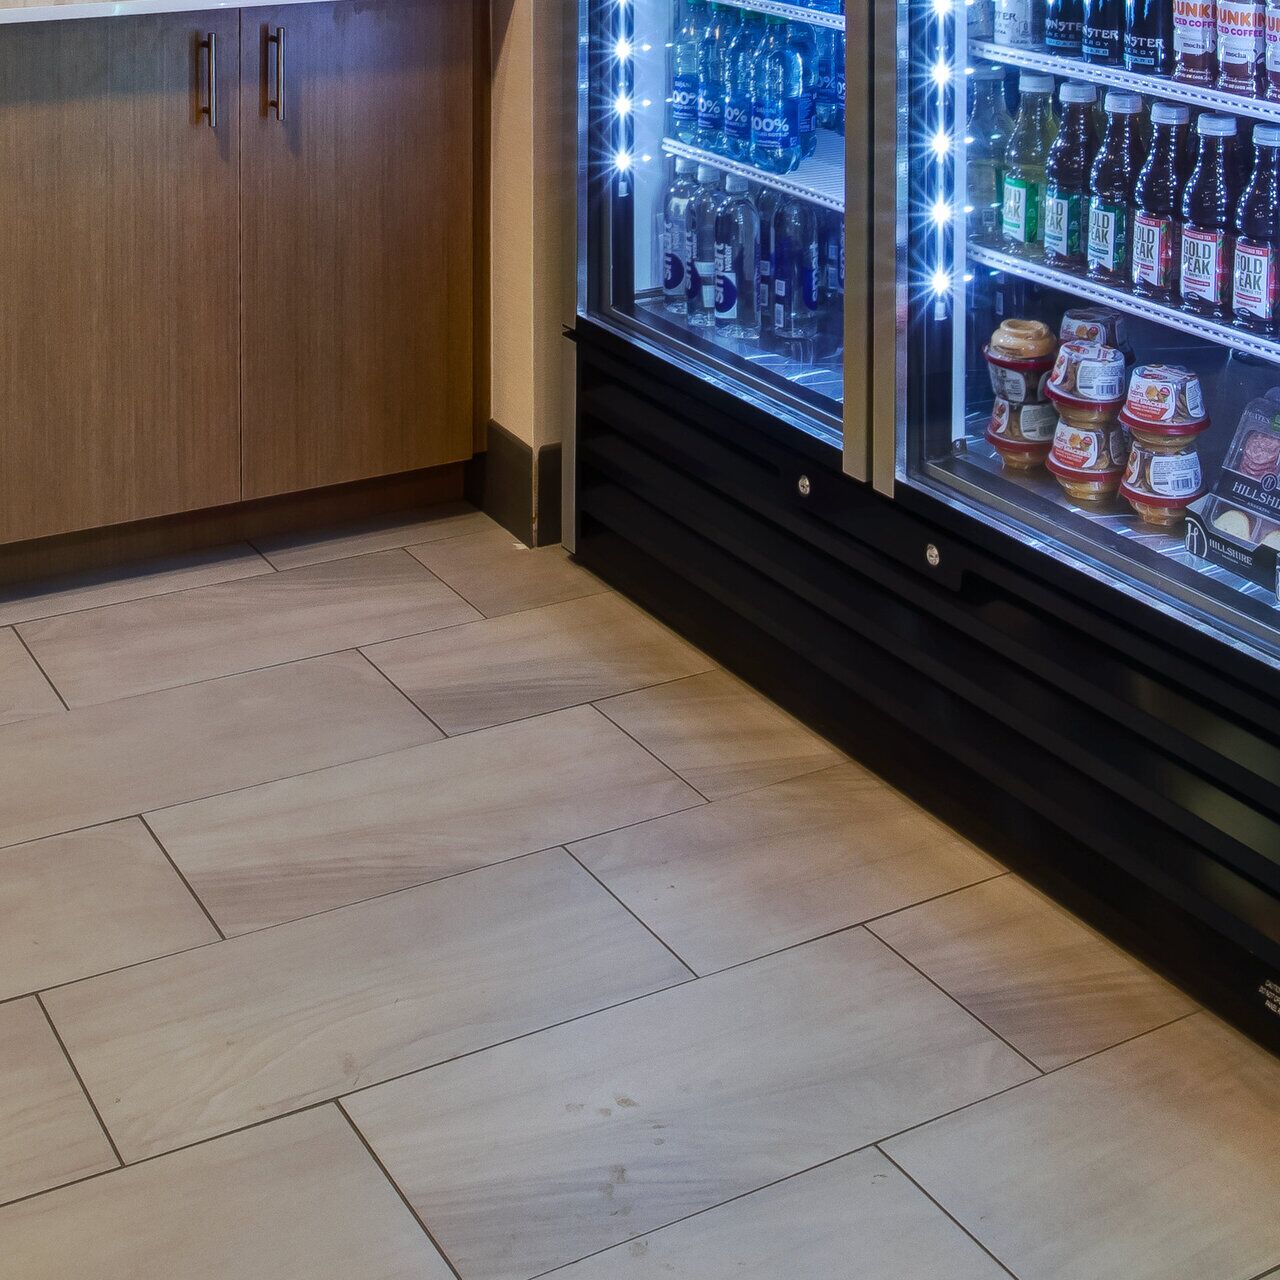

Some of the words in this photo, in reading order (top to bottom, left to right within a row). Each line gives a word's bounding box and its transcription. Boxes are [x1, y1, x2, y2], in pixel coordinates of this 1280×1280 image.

[1183, 41, 1206, 51] mocha
[1225, 50, 1247, 59] mocha
[724, 245, 733, 272] water
[1183, 238, 1211, 260] GOLD
[1183, 257, 1210, 276] PEAK
[1209, 538, 1253, 567] HILLSHIRE
